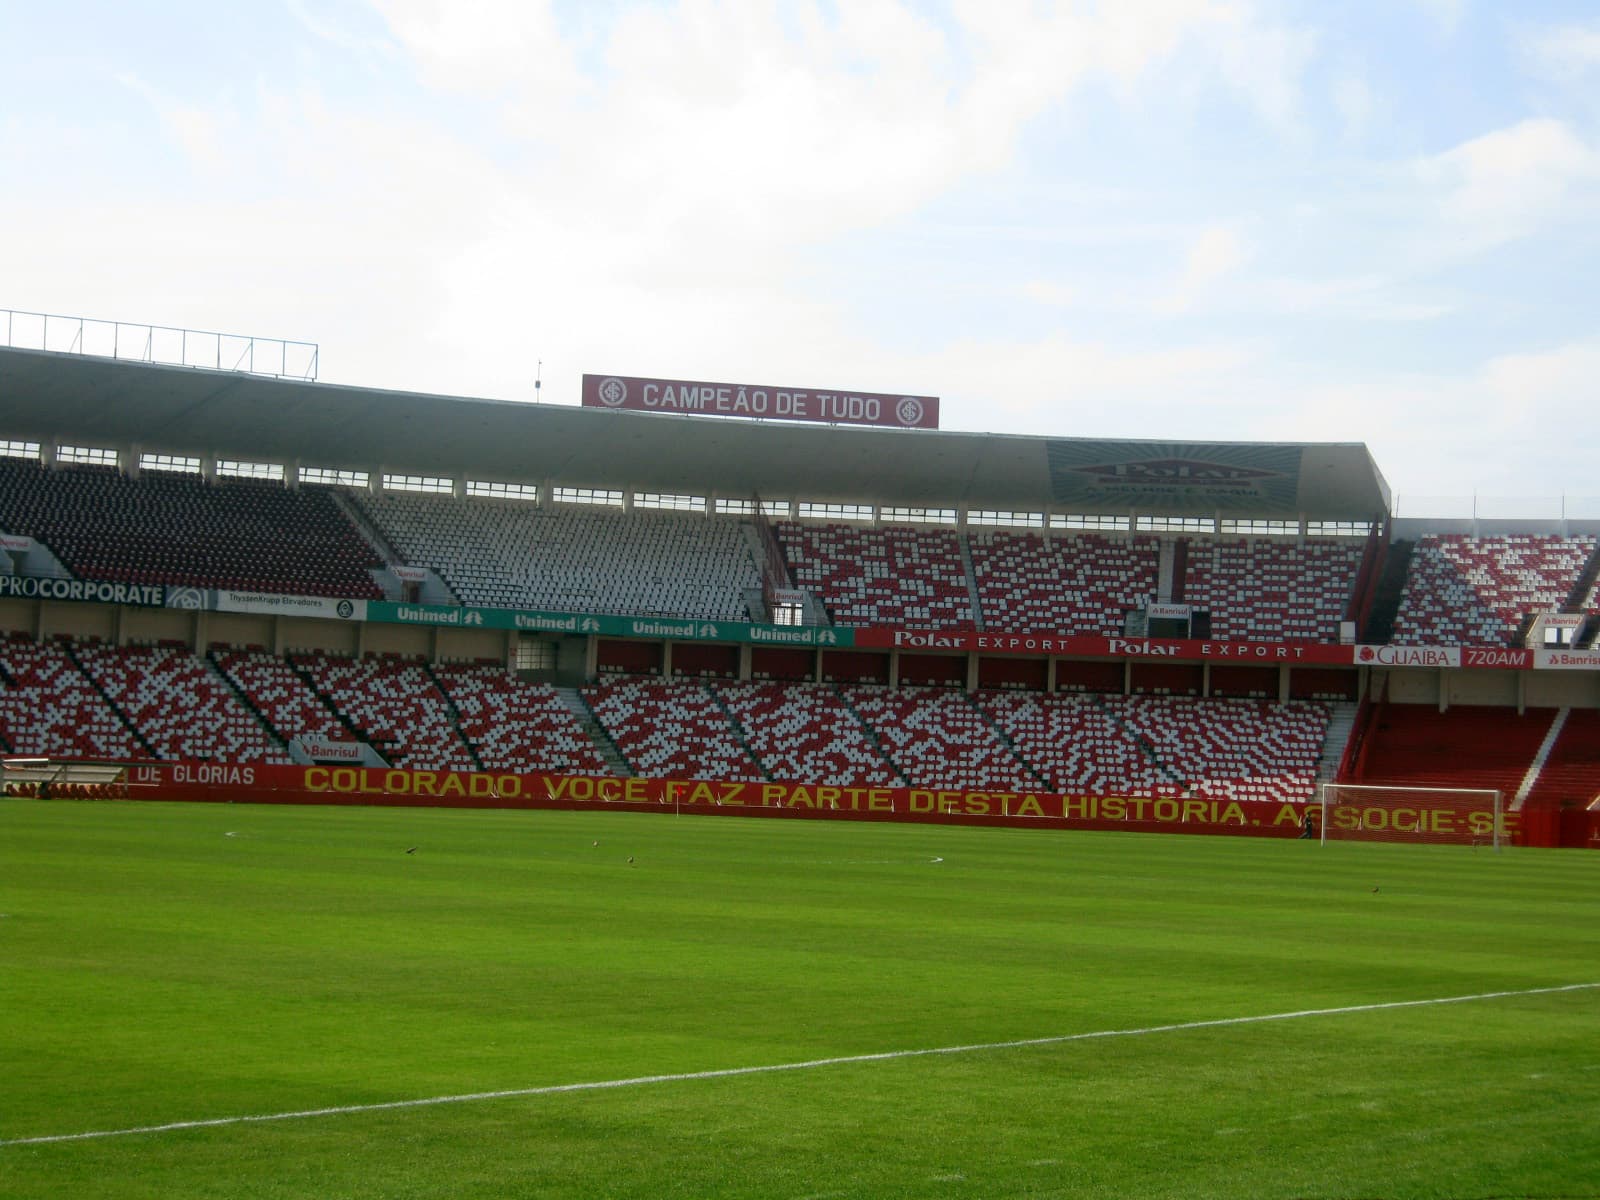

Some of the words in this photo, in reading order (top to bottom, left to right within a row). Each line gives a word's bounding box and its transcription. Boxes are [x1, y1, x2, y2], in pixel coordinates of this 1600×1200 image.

[643, 383, 768, 413] CAMPEÃO
[776, 392, 807, 416] DE
[816, 394, 881, 420] TUDO
[0, 576, 163, 605] PROCORPORATE
[397, 606, 458, 624] Unimed
[515, 614, 576, 631] Unimed
[632, 620, 694, 637] Unimed
[750, 626, 812, 642] Unimed
[894, 631, 967, 648] Polar
[978, 636, 1068, 650] EXPORT
[1109, 639, 1181, 656] Polar
[1201, 644, 1304, 658] EXPORT
[1467, 651, 1526, 665] 720AM
[1561, 654, 1600, 665] Banris
[311, 745, 359, 758] Banrisul
[138, 766, 162, 781] DE
[173, 762, 255, 785] GLÓRIAS
[665, 780, 746, 805] FAZ
[762, 784, 900, 812] PARTE
[909, 789, 1046, 818] DESTA
